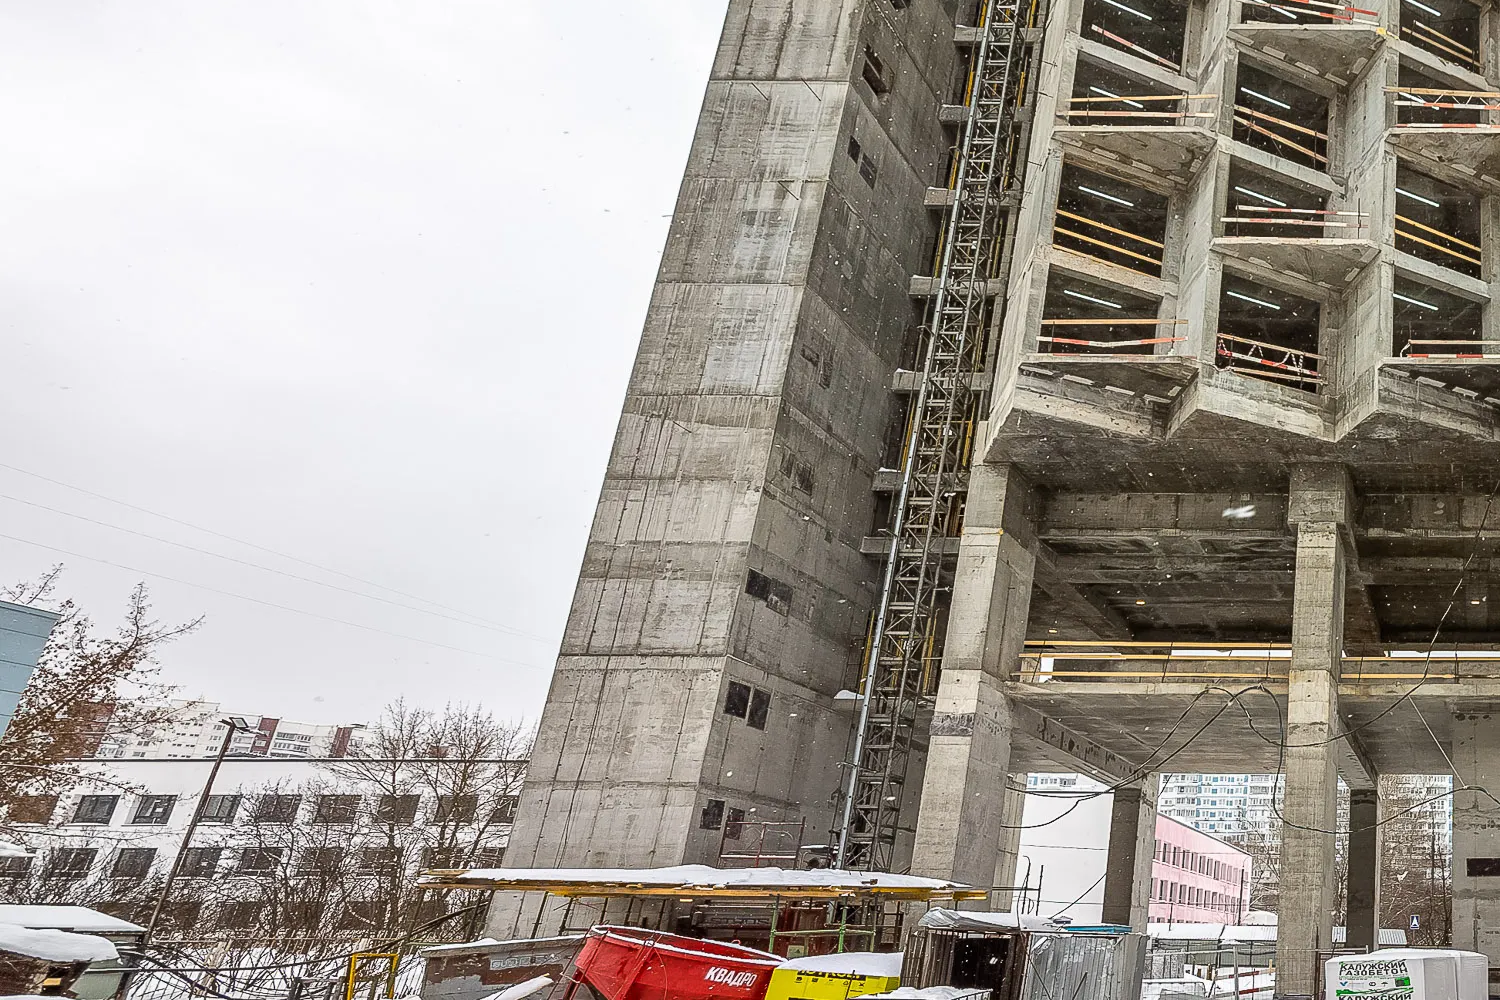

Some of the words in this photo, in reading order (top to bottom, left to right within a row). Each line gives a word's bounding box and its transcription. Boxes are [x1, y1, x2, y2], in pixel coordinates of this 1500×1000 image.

[1340, 961, 1406, 971] КАЛУЖСКИЙ
[705, 966, 757, 987] КВАДРО
[1340, 968, 1408, 976] ГАЗОБЕТОН
